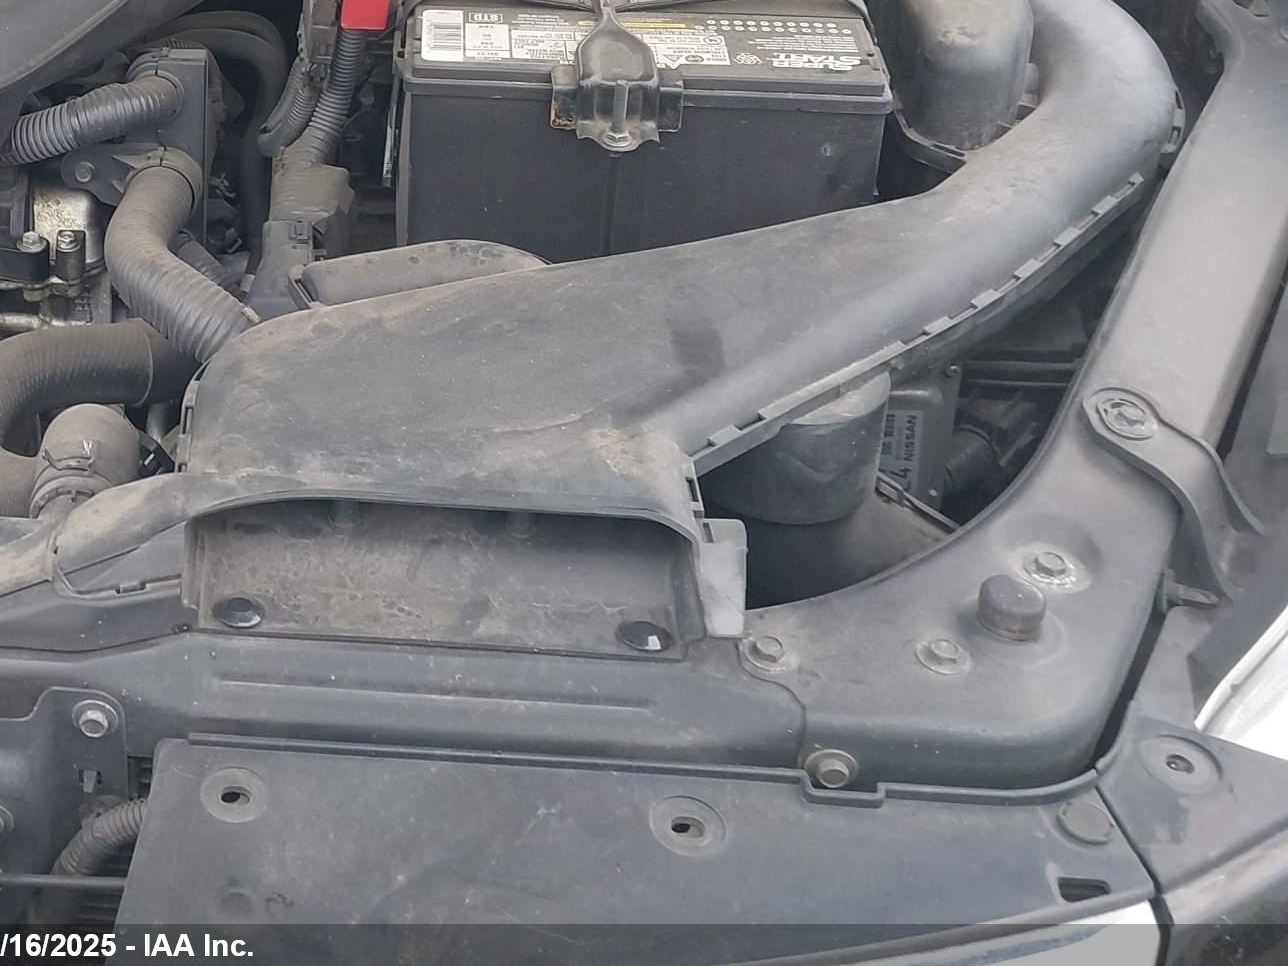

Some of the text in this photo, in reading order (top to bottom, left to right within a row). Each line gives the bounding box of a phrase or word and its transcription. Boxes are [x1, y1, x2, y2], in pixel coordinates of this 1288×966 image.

[473, 13, 499, 21] STD
[772, 52, 862, 65] START
[772, 58, 854, 71] SUPER
[903, 415, 917, 462] NISSAN
